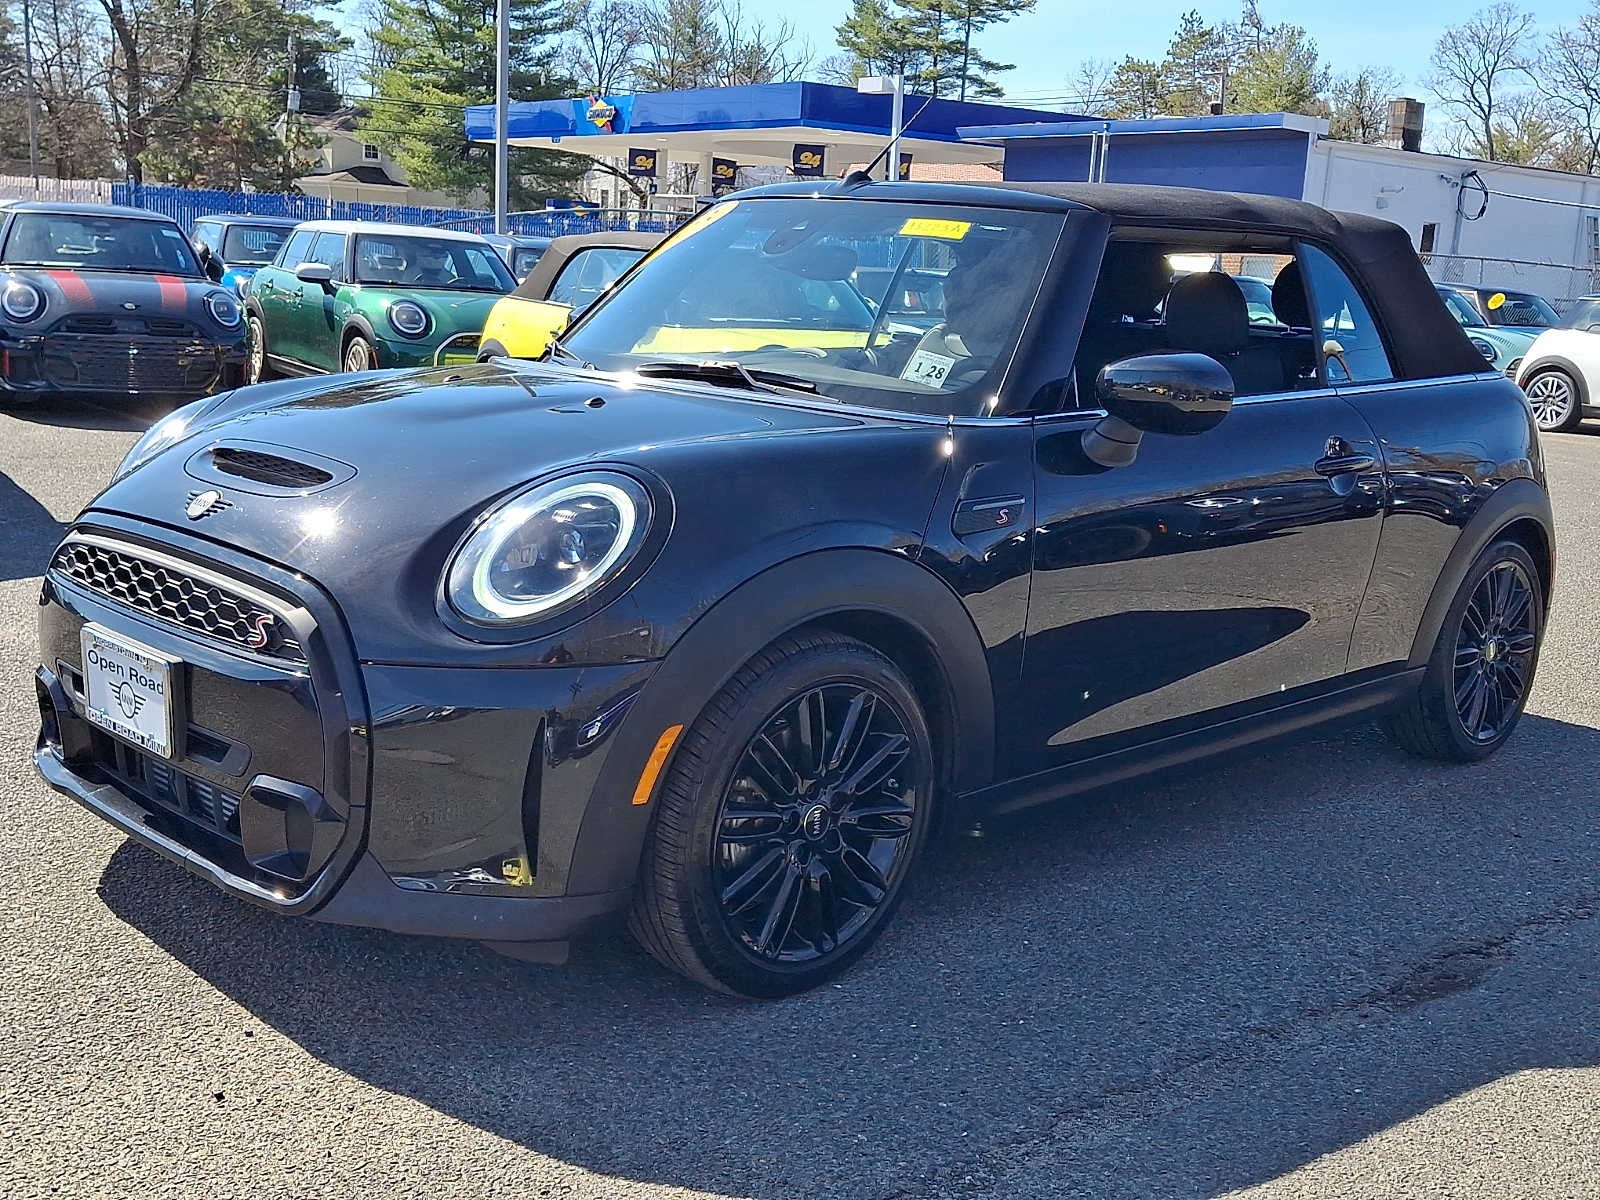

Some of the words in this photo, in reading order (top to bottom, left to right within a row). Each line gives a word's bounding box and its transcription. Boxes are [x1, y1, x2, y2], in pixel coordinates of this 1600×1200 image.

[800, 151, 821, 168] 94
[914, 362, 923, 373] 1
[926, 365, 945, 379] 28
[995, 508, 1009, 525] S
[247, 614, 274, 649] S
[88, 649, 125, 678] Open
[129, 667, 164, 695] Road
[89, 709, 113, 730] OPEN
[116, 721, 141, 742] ROAD
[145, 738, 167, 756] MINI
[813, 809, 821, 835] MINI
